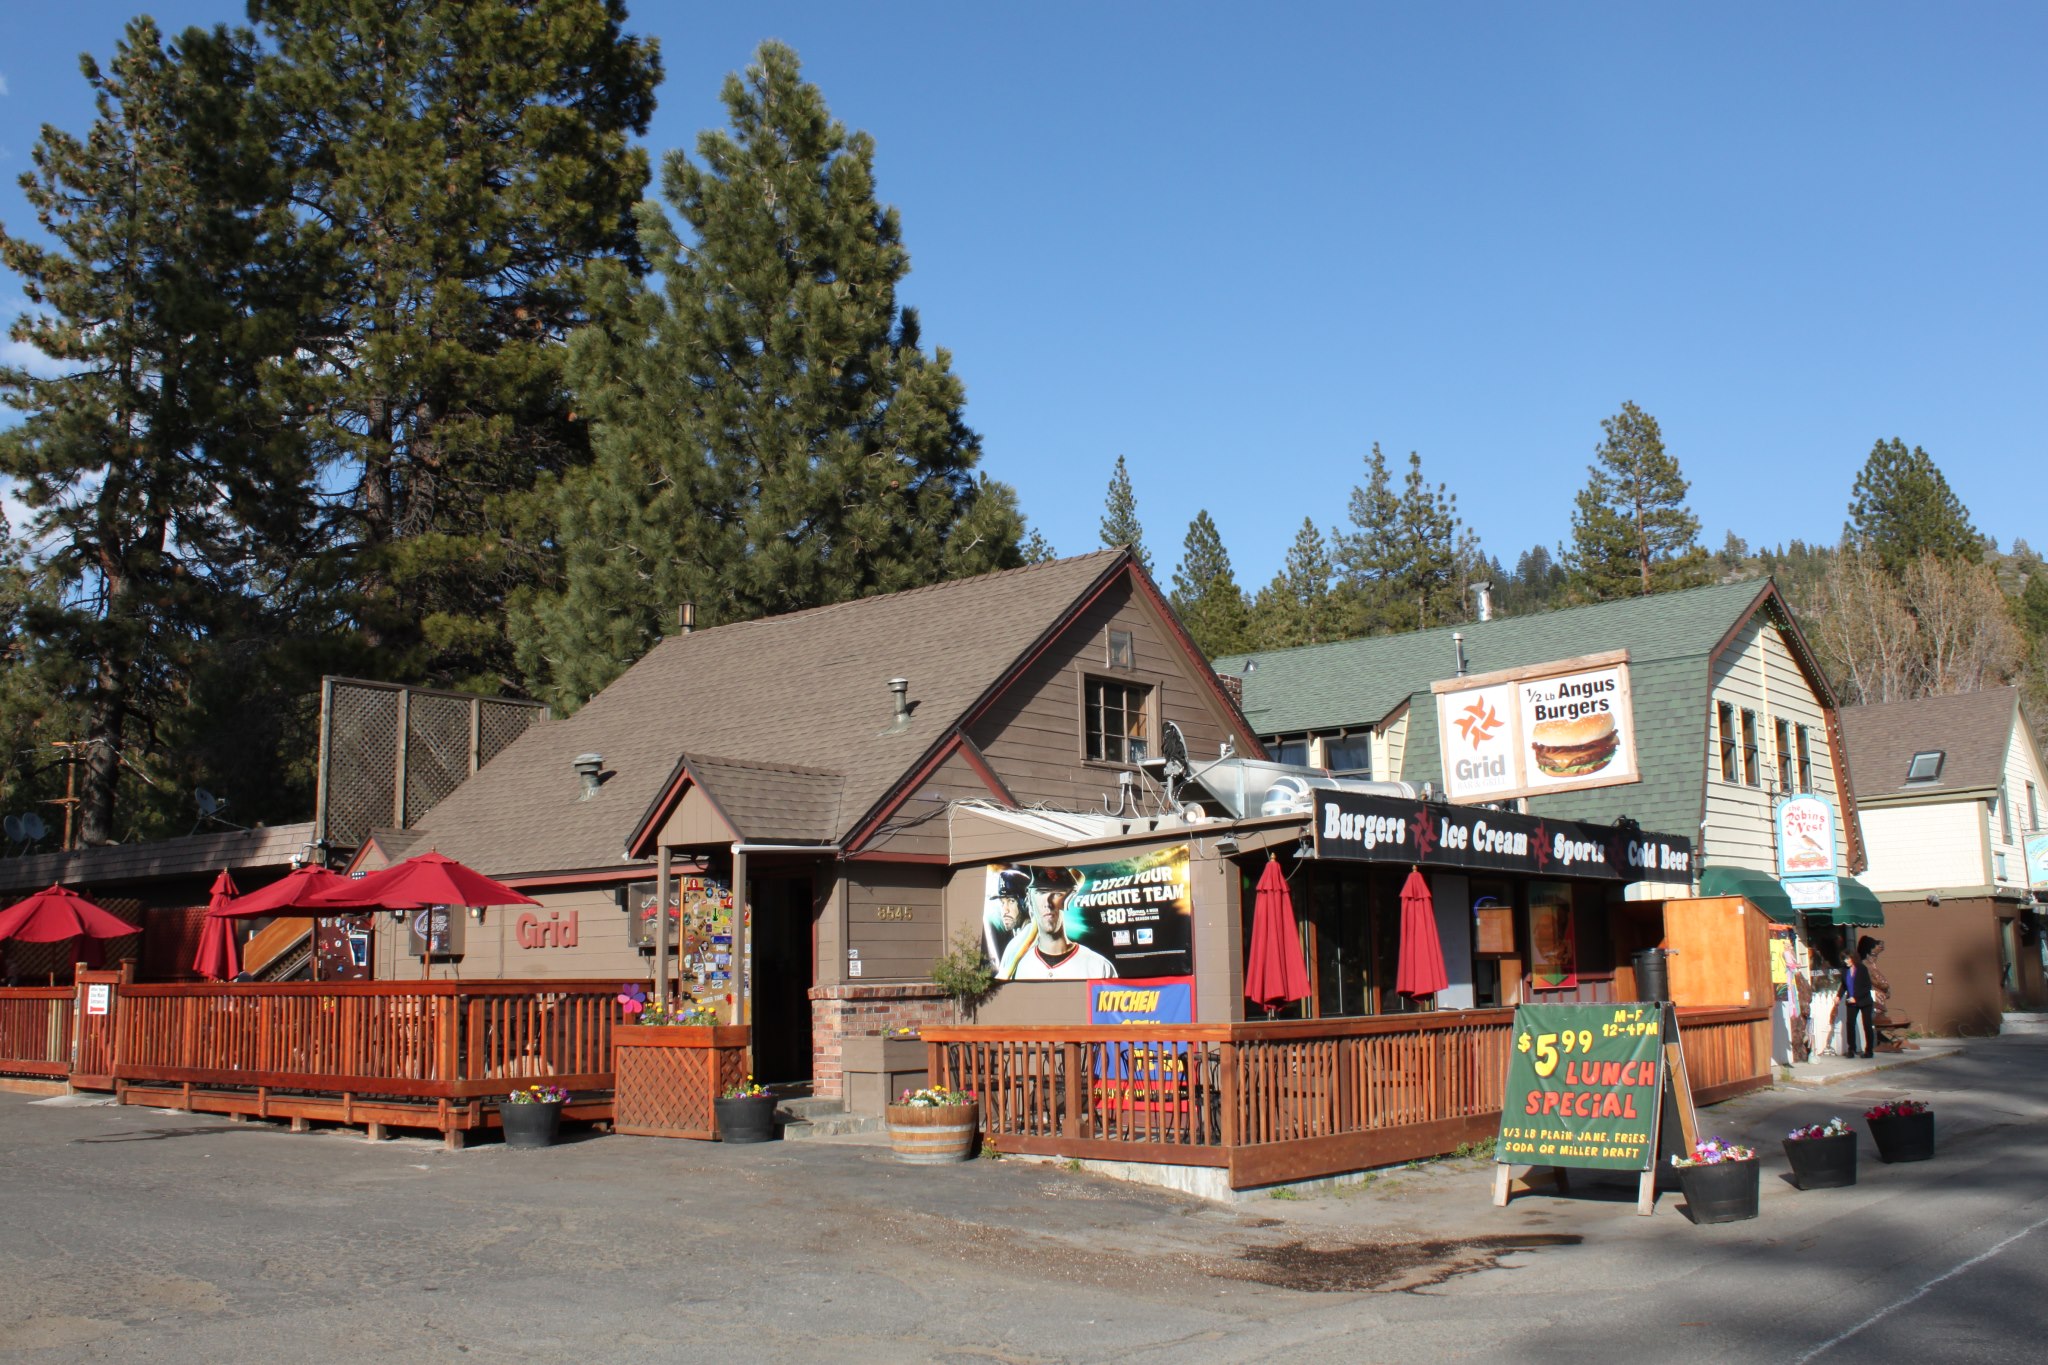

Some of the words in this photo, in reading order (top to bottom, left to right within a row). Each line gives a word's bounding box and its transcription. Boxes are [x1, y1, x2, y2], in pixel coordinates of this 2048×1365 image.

[1558, 678, 1616, 699] Angus
[1535, 698, 1610, 721] Burgers
[1455, 754, 1506, 781] Grid
[1323, 802, 1406, 850] Burgers
[1440, 816, 1468, 850] Ice
[1472, 820, 1528, 856] Cream
[1553, 832, 1605, 866] Sports
[1628, 840, 1657, 869] Cold
[1660, 843, 1689, 871] Beer
[1091, 873, 1133, 892] CATCH
[1133, 866, 1173, 885] YOUR
[1073, 887, 1141, 908] FAVORITE
[1143, 883, 1185, 903] TEAM
[1106, 907, 1126, 924] 80
[515, 909, 579, 949] Grid
[1097, 990, 1160, 1014] KITCHEN
[1614, 1010, 1643, 1023] M-F
[1602, 1022, 1659, 1037] 12-4PM
[1565, 1061, 1656, 1087] LUNCH
[1525, 1090, 1638, 1119] SPECIAL
[1503, 1127, 1520, 1139] 1/3
[1524, 1129, 1537, 1140] LB
[1541, 1129, 1573, 1141] PLAIN
[1505, 1141, 1534, 1153] SODA
[1539, 1144, 1556, 1154] OR
[1559, 1145, 1599, 1157] MILLER
[1602, 1147, 1640, 1159] DRAFT
